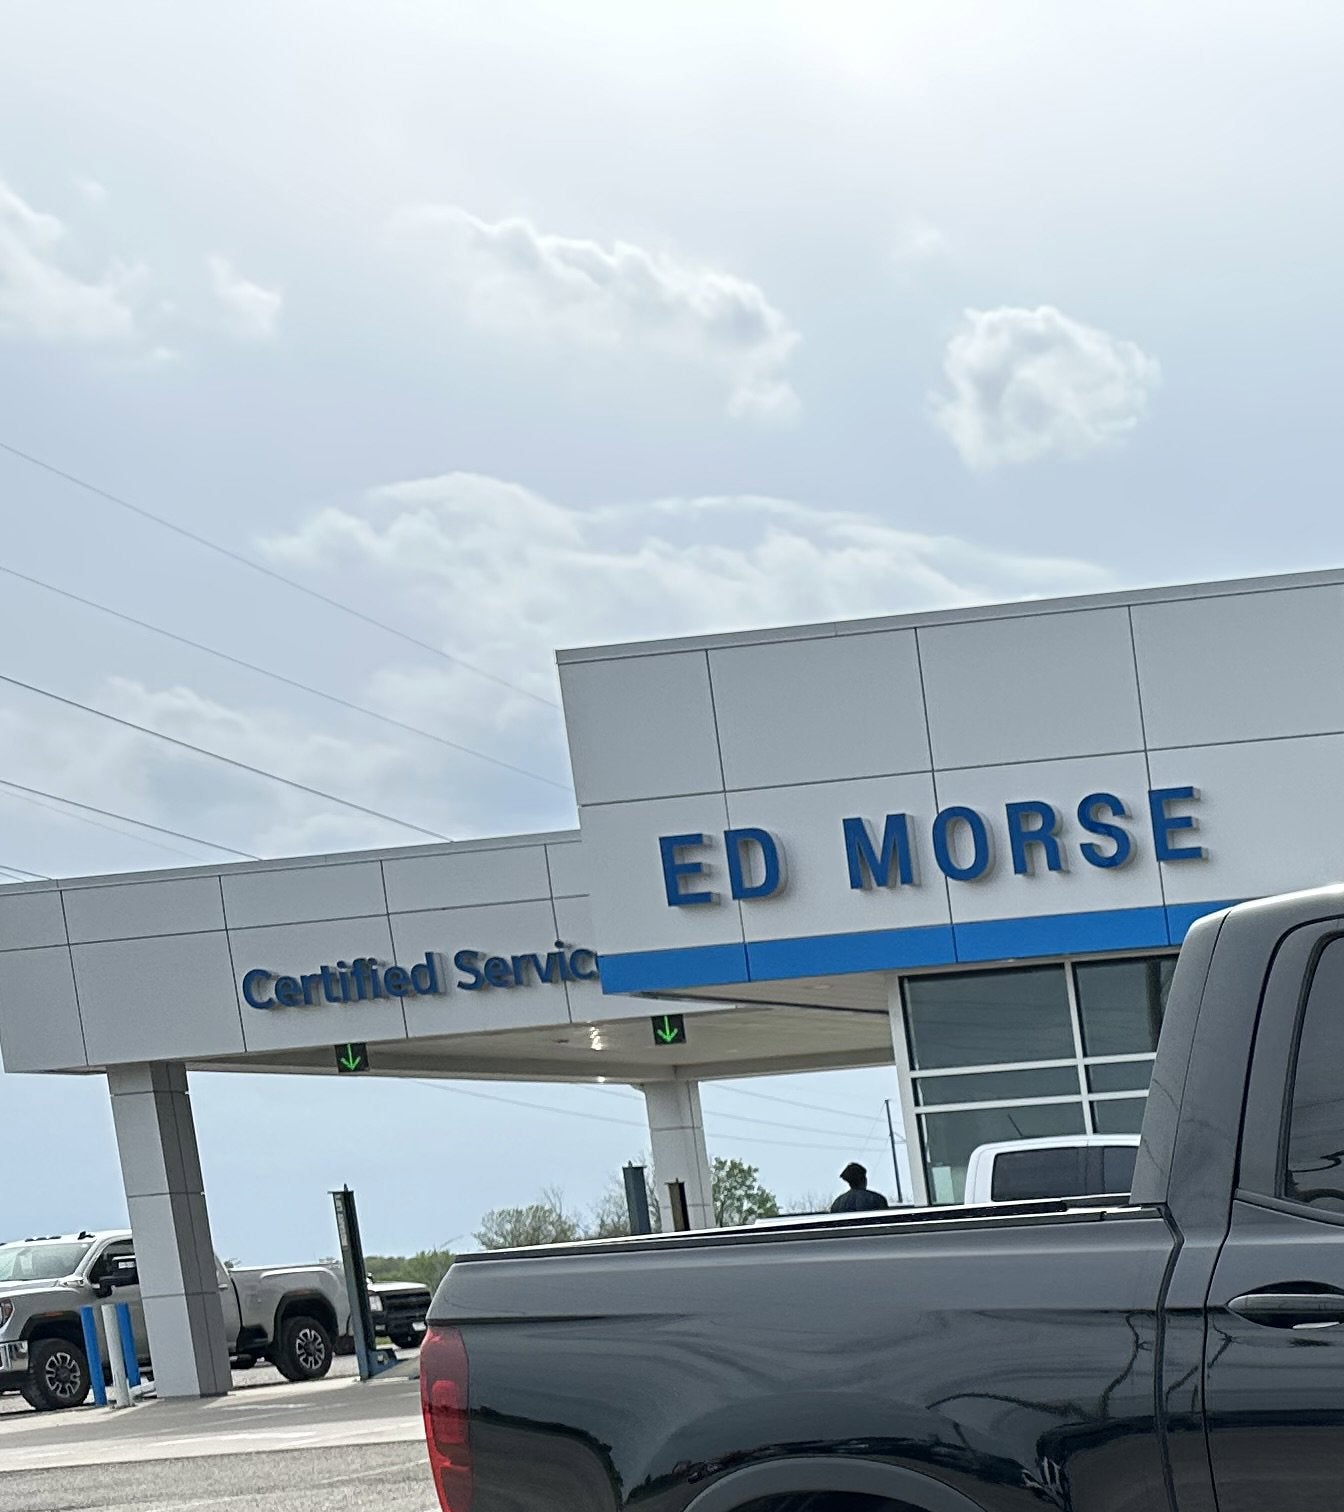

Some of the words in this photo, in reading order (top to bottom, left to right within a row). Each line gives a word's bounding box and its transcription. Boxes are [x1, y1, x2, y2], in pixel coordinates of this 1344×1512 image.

[658, 826, 789, 908] ED
[841, 785, 1209, 891] MORSE
[241, 950, 446, 1010] Certified
[453, 939, 600, 991] Servic
